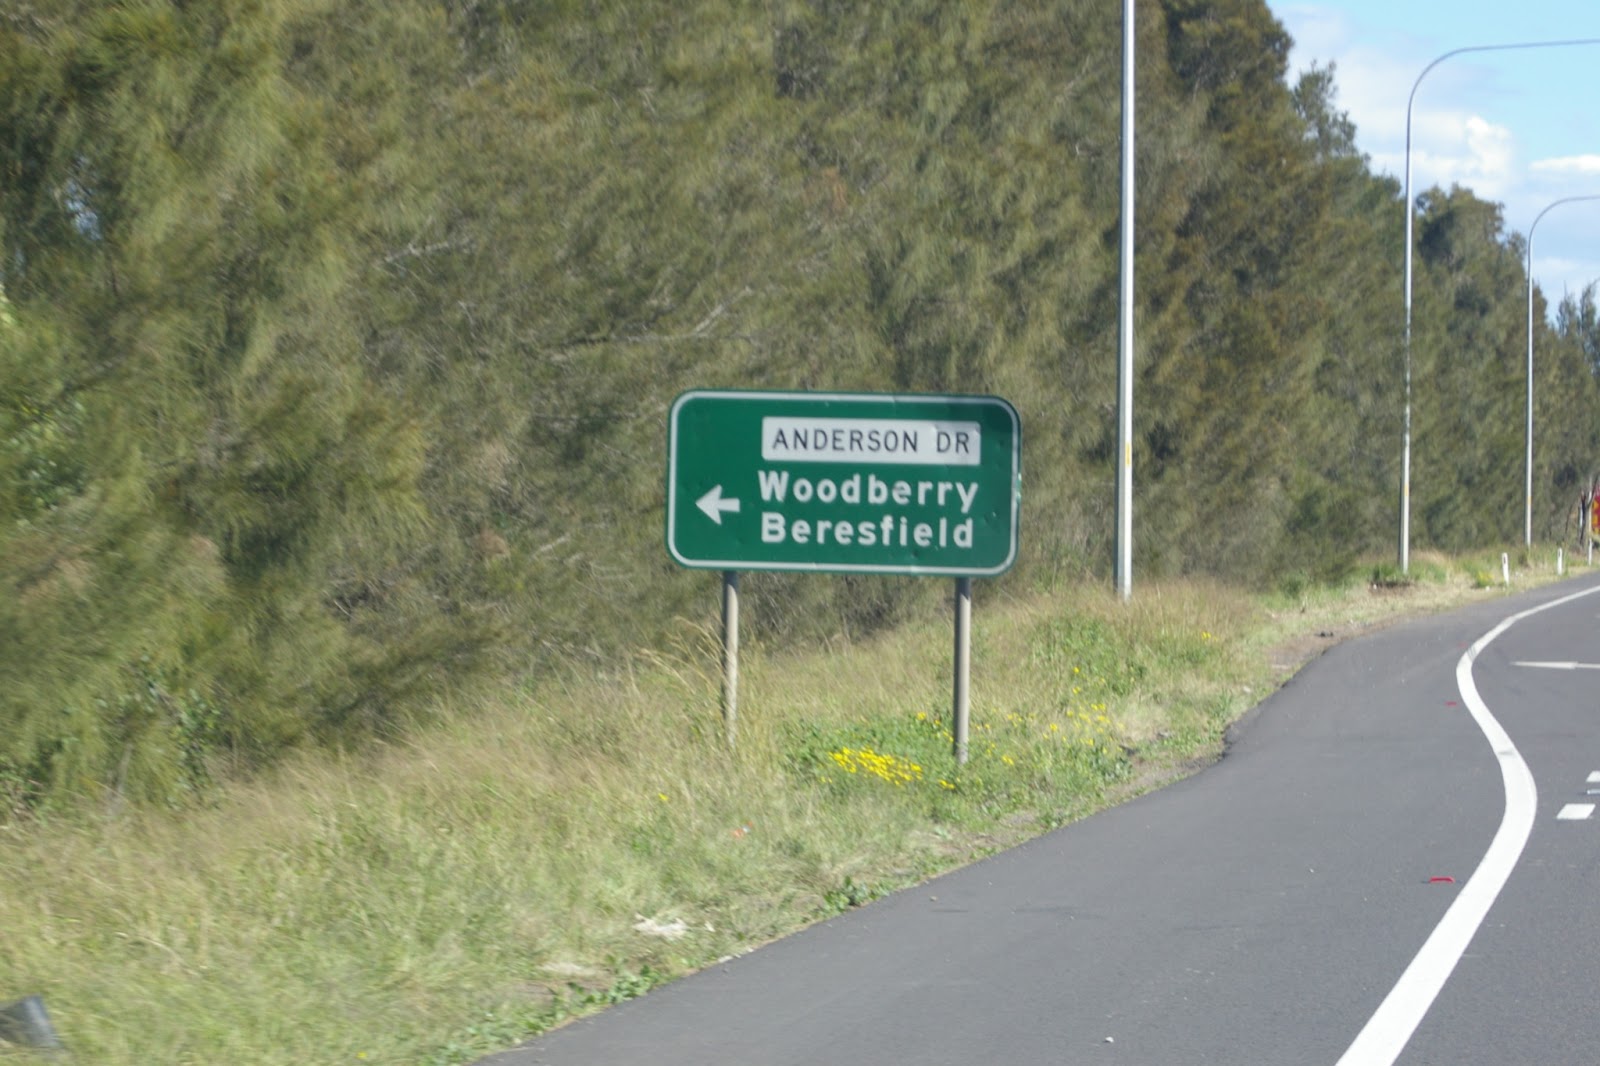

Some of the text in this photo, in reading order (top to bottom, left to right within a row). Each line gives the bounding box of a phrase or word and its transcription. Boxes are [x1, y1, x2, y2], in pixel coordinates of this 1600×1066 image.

[772, 428, 970, 454] ANDERSON DR
[758, 470, 979, 513] Woodberry
[761, 512, 973, 548] Beresfield
